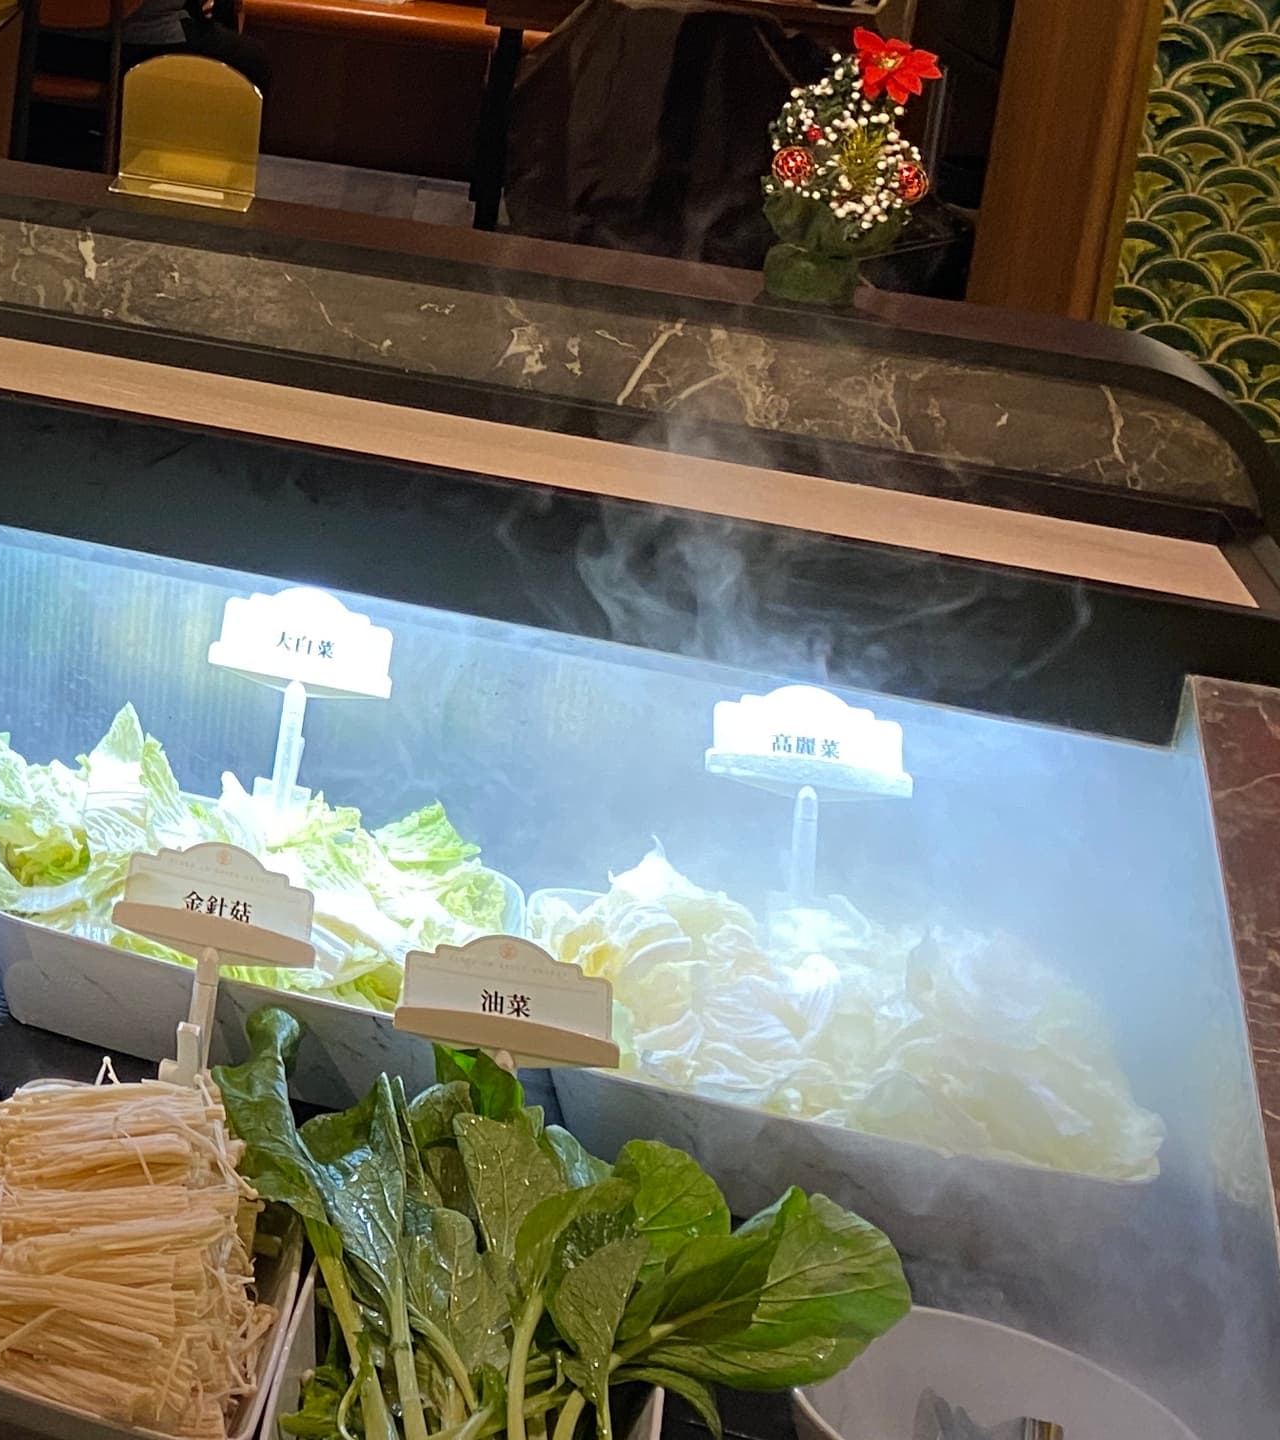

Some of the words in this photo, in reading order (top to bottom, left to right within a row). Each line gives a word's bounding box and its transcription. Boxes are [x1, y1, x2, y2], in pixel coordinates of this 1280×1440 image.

[275, 630, 337, 661] 大白菜
[771, 733, 841, 760] 高麗菜
[183, 890, 254, 924] 金針菇
[480, 988, 532, 1018] 油菜
